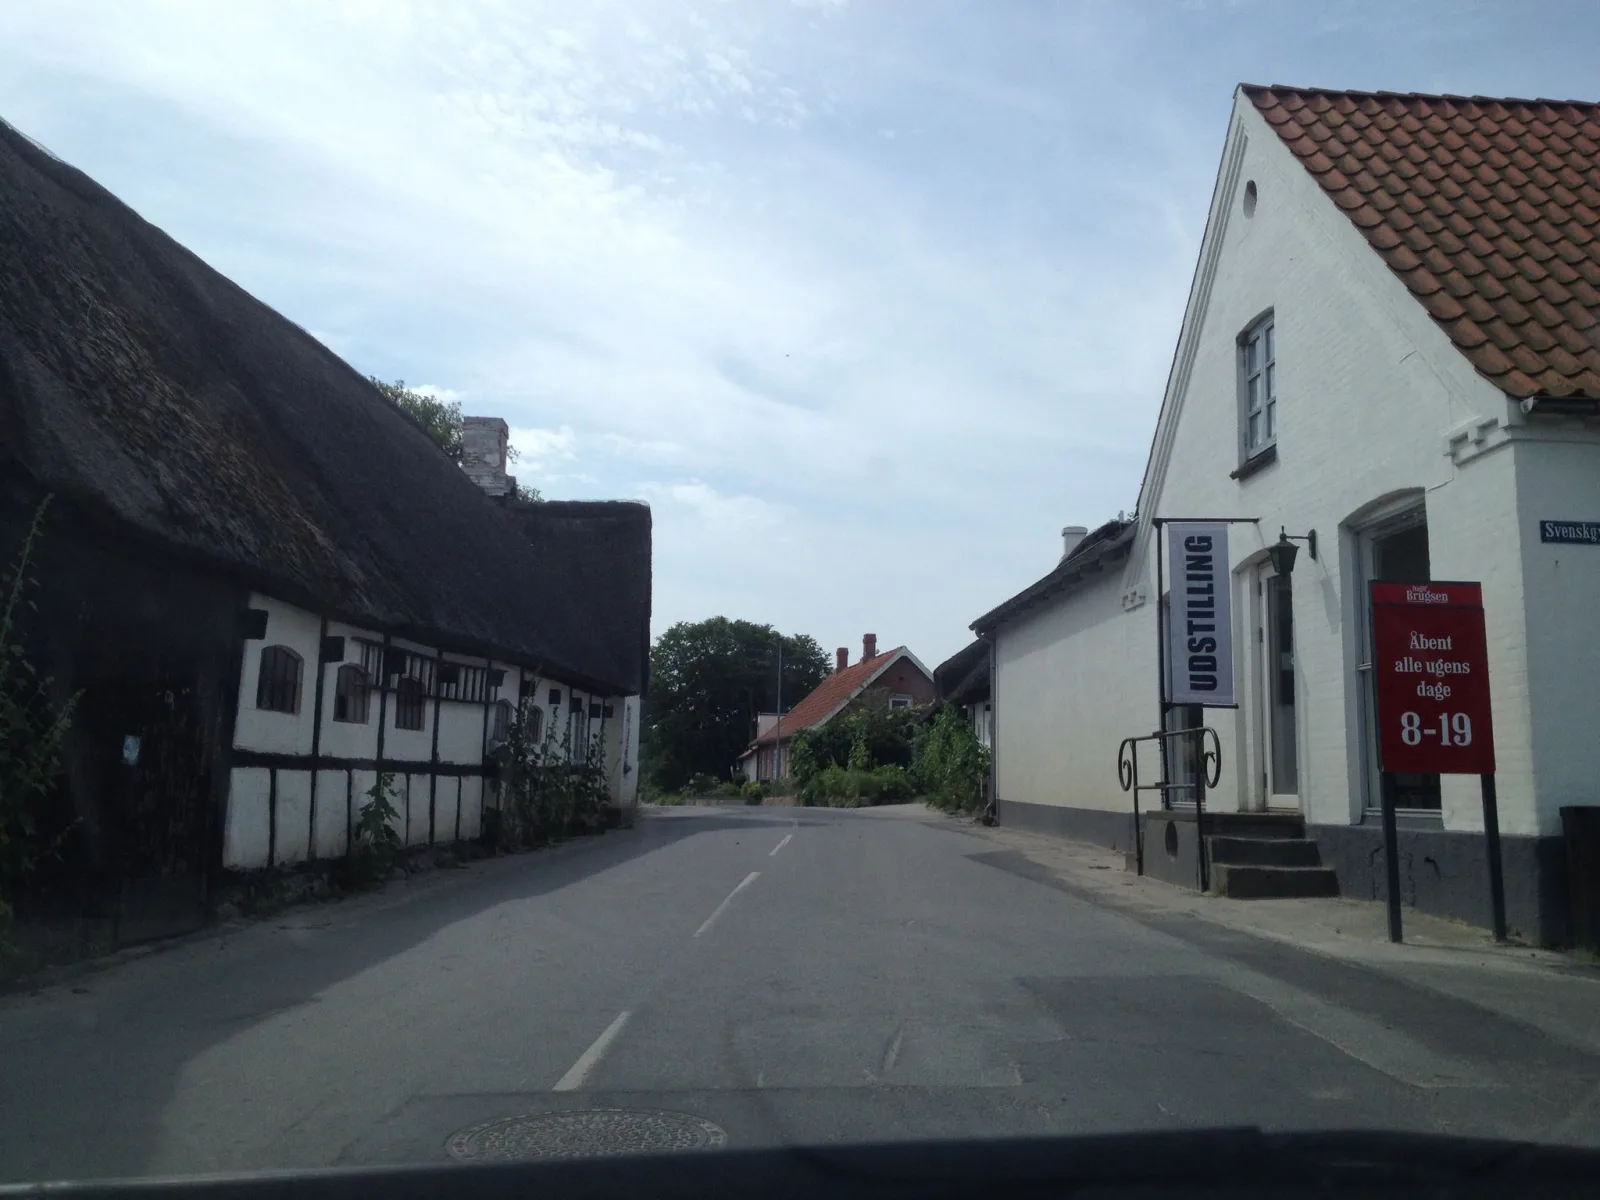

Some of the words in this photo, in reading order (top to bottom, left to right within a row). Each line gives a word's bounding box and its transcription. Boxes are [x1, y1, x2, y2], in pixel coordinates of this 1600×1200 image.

[1545, 522, 1600, 542] Svenskg
[1406, 590, 1448, 603] Brugsen
[1184, 536, 1218, 691] UDSTILLING
[1410, 631, 1452, 650] Åbent
[1395, 657, 1422, 673] alle
[1426, 659, 1470, 677] ugens
[1416, 681, 1451, 700] dage
[1400, 711, 1472, 746] 8-19
